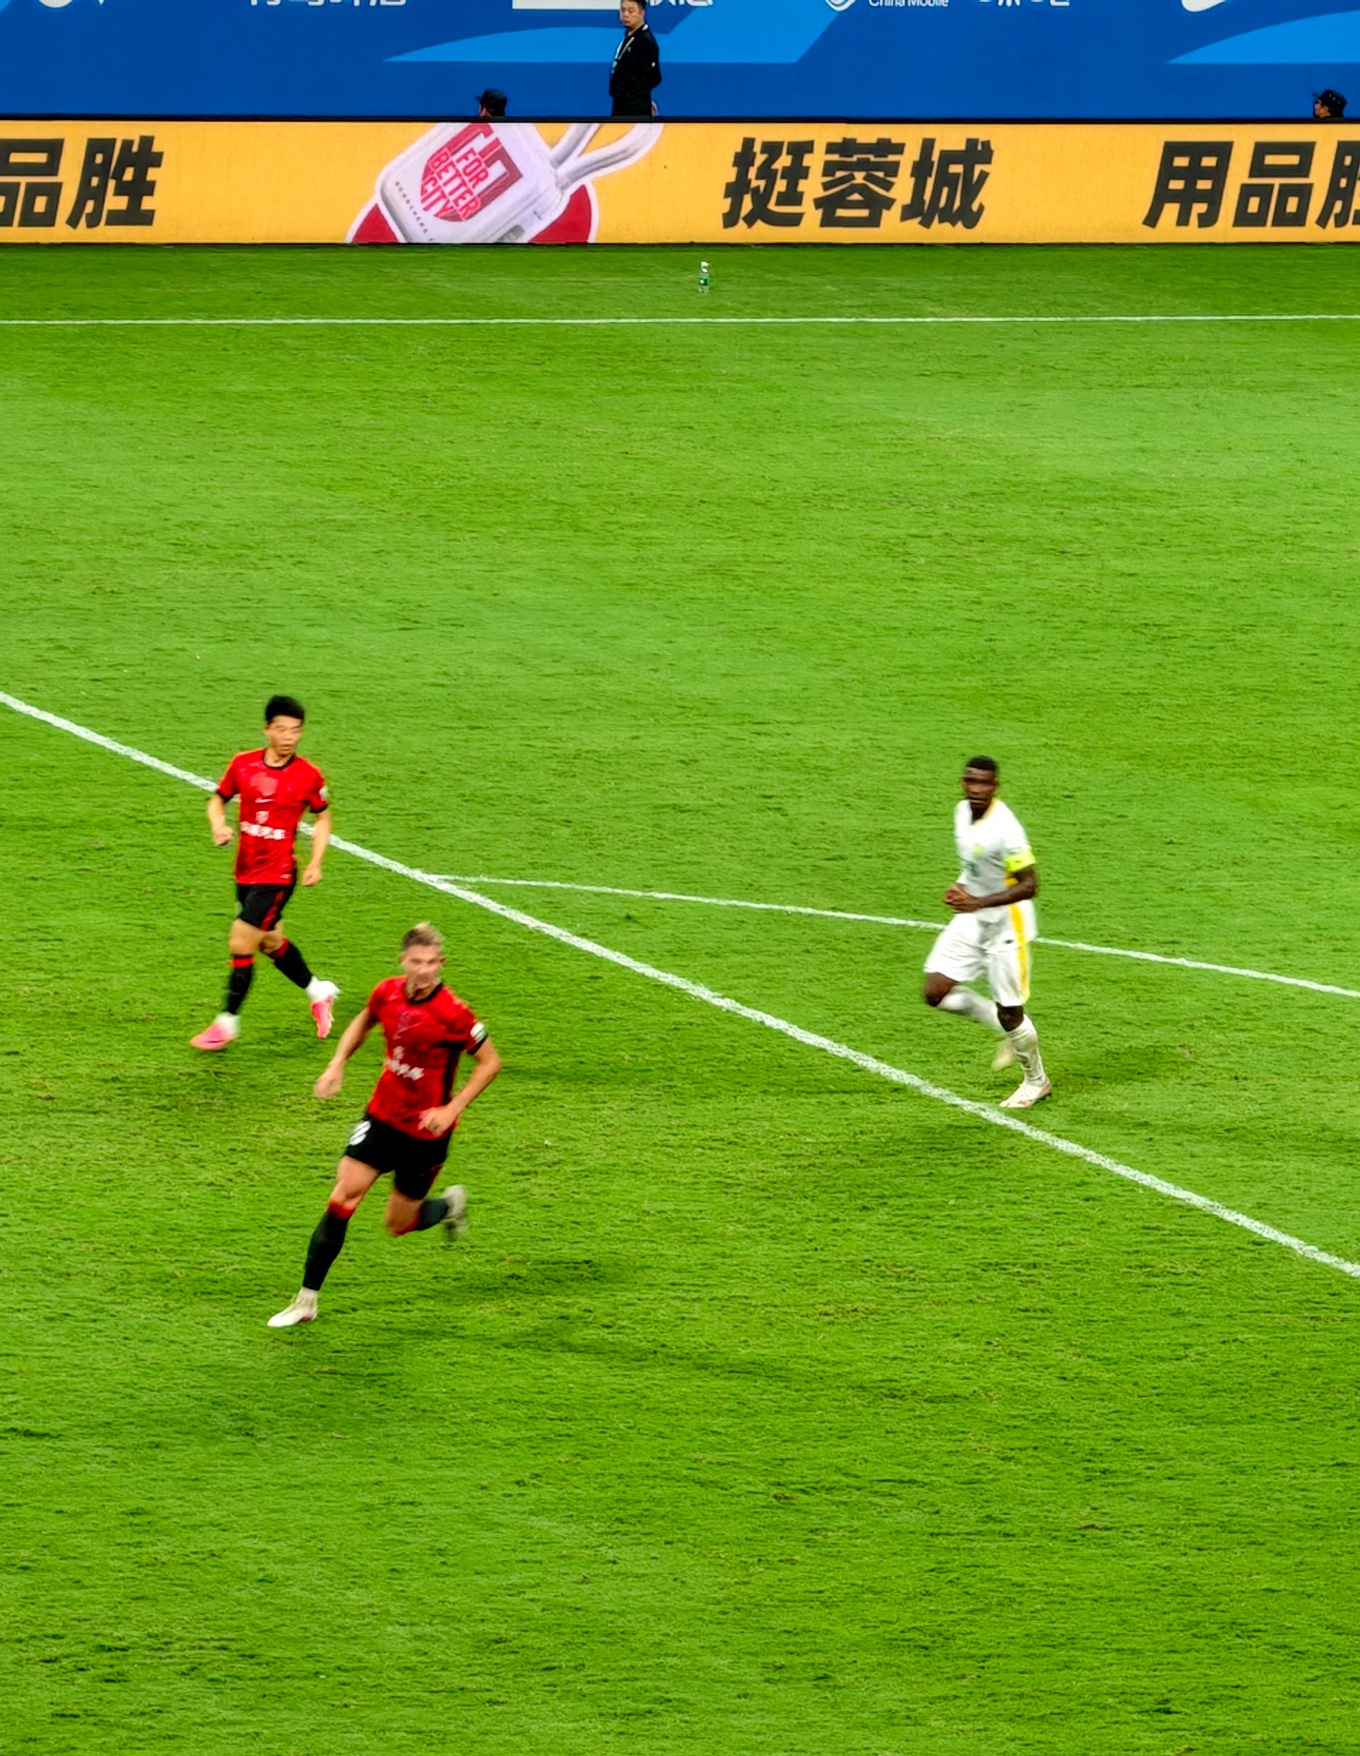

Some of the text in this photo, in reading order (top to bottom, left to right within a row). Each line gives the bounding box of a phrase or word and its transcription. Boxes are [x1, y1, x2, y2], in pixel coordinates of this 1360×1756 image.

[420, 174, 457, 218] CITY
[428, 148, 480, 220] BETTER
[455, 147, 490, 190] FOR
[722, 137, 994, 230] 挺蓉城
